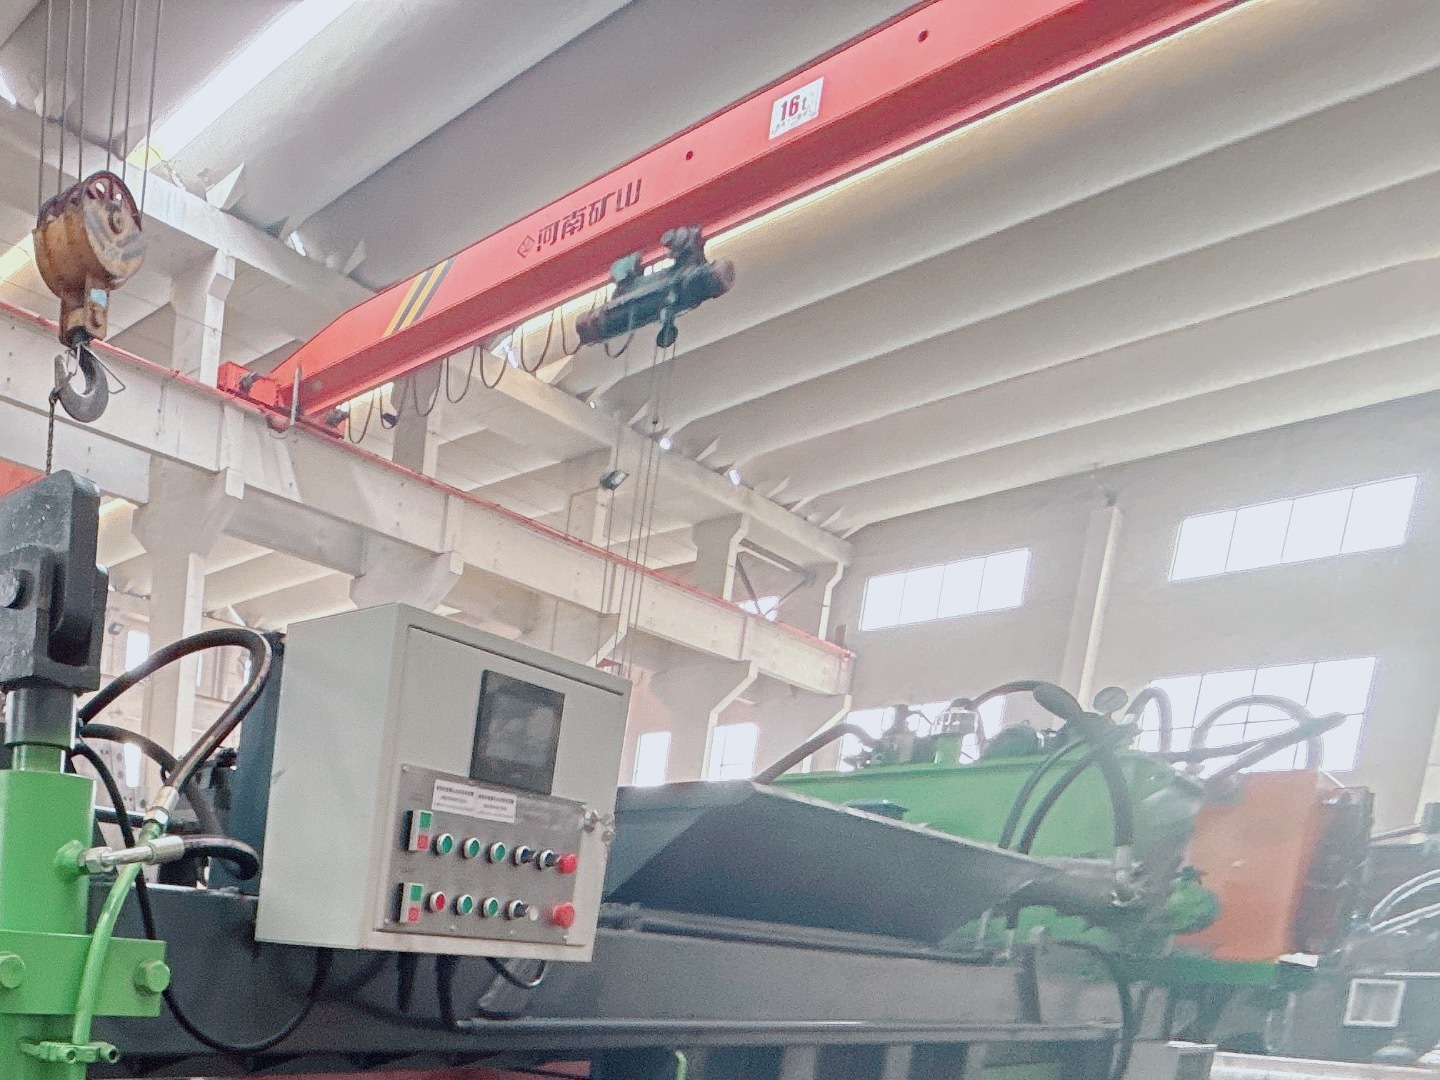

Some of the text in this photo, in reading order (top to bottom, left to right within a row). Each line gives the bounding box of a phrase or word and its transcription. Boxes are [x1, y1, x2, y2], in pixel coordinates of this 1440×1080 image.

[781, 94, 807, 121] 16t
[537, 179, 642, 252] 河南矿山
